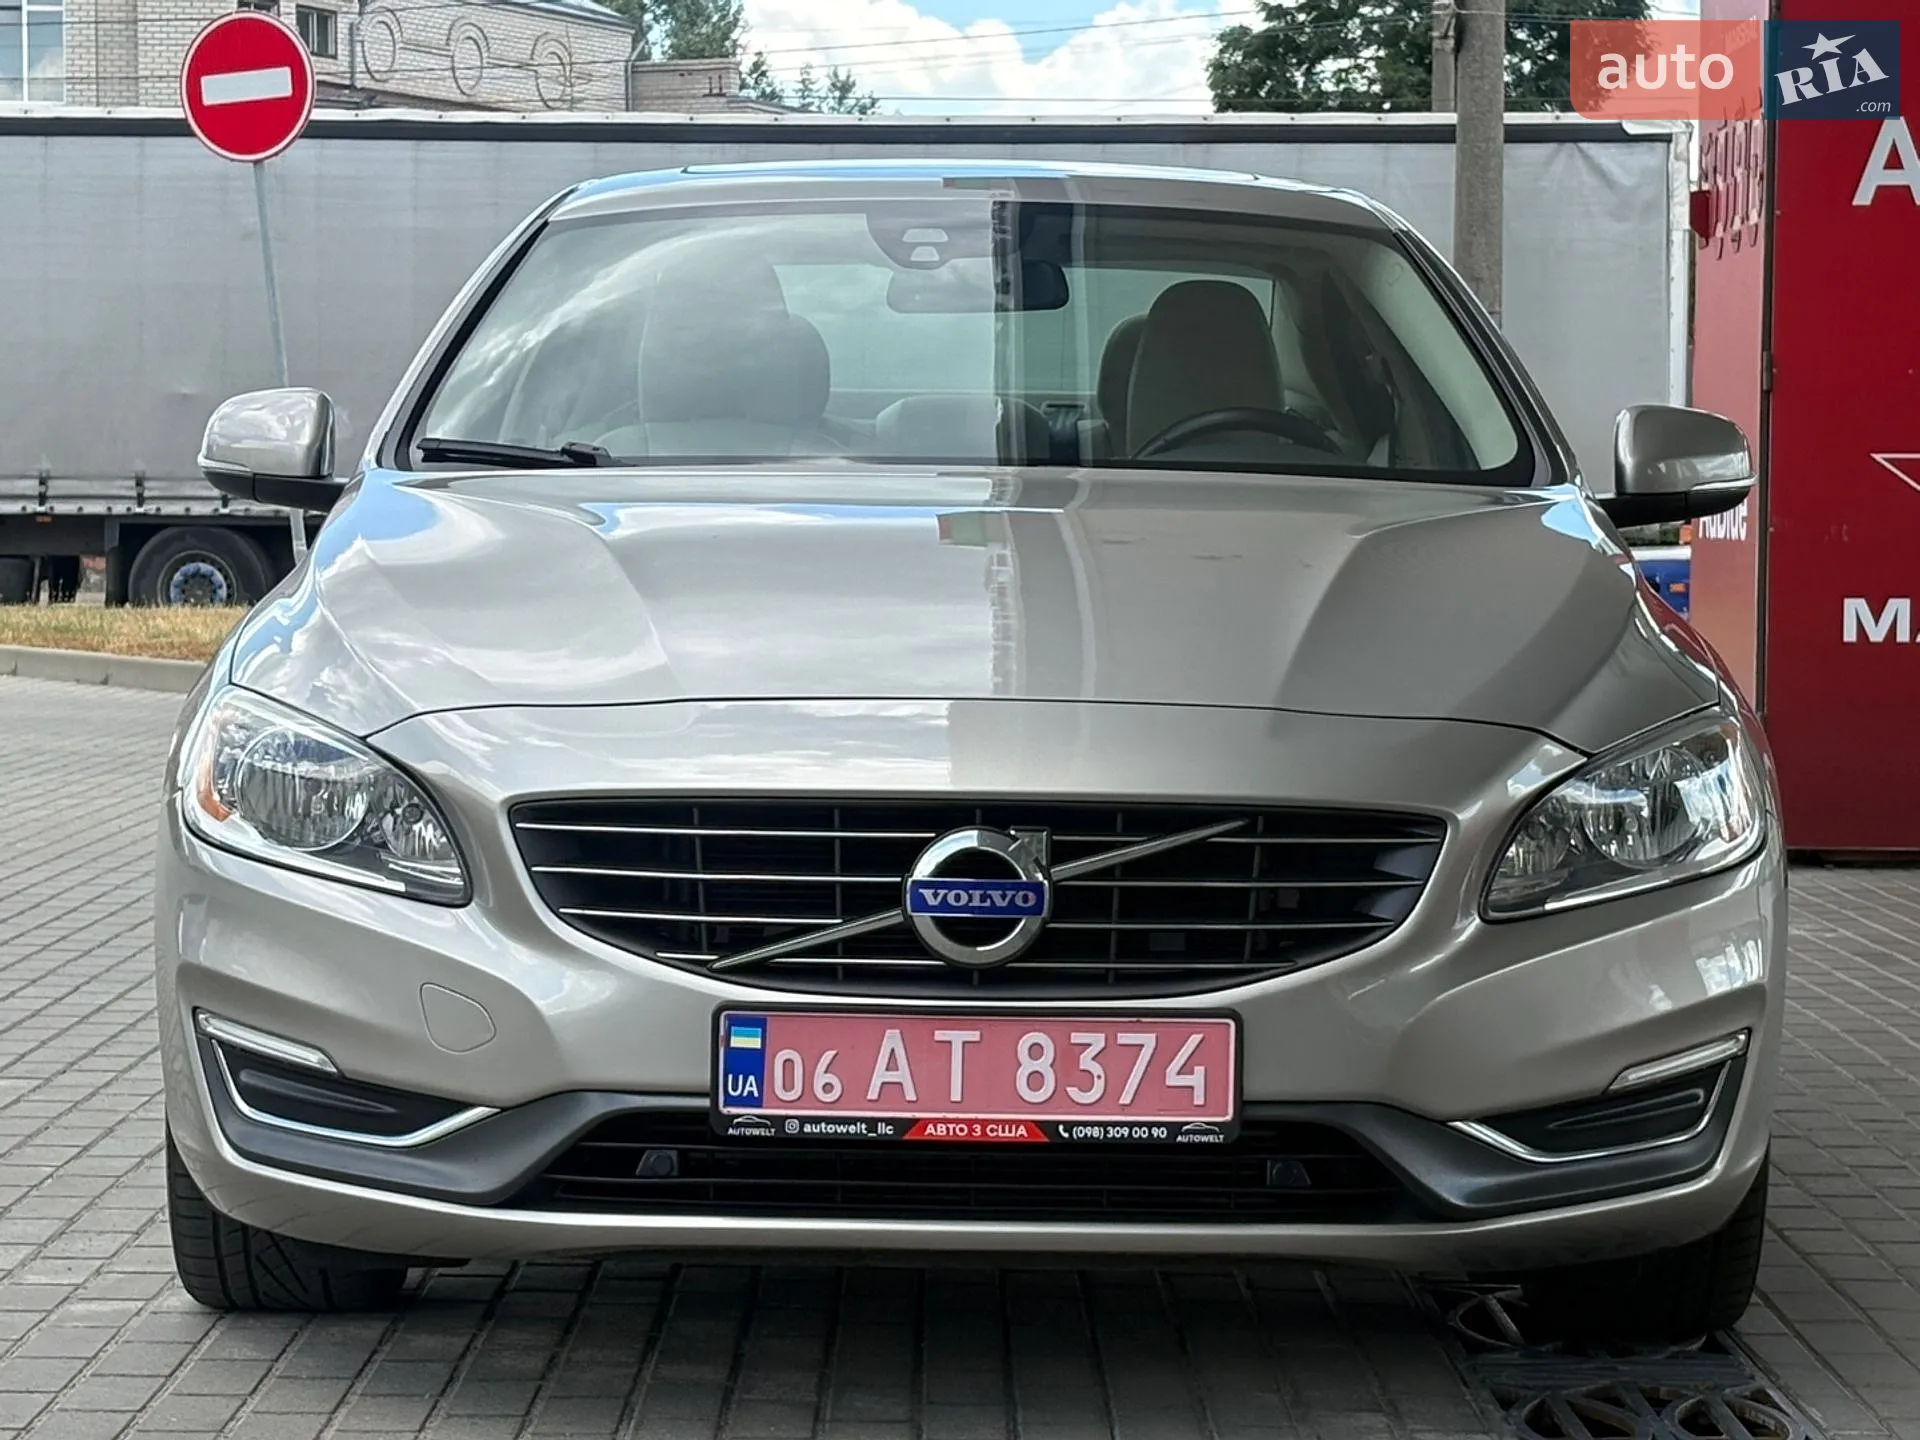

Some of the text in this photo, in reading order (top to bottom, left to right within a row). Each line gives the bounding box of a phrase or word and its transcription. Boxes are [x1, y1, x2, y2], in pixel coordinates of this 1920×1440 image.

[1843, 597, 1920, 643] M
[918, 888, 1037, 908] VOLVO
[773, 1029, 1206, 1106] 06 AT 8374
[727, 1074, 759, 1097] UA
[727, 1126, 776, 1137] AUTOWELT
[803, 1121, 894, 1137] autowelt_llc
[924, 1123, 968, 1136] АВТО
[986, 1124, 1028, 1137] США
[1072, 1126, 1168, 1140] (098) 309 00 90
[1176, 1133, 1225, 1143] AUTOWELT
